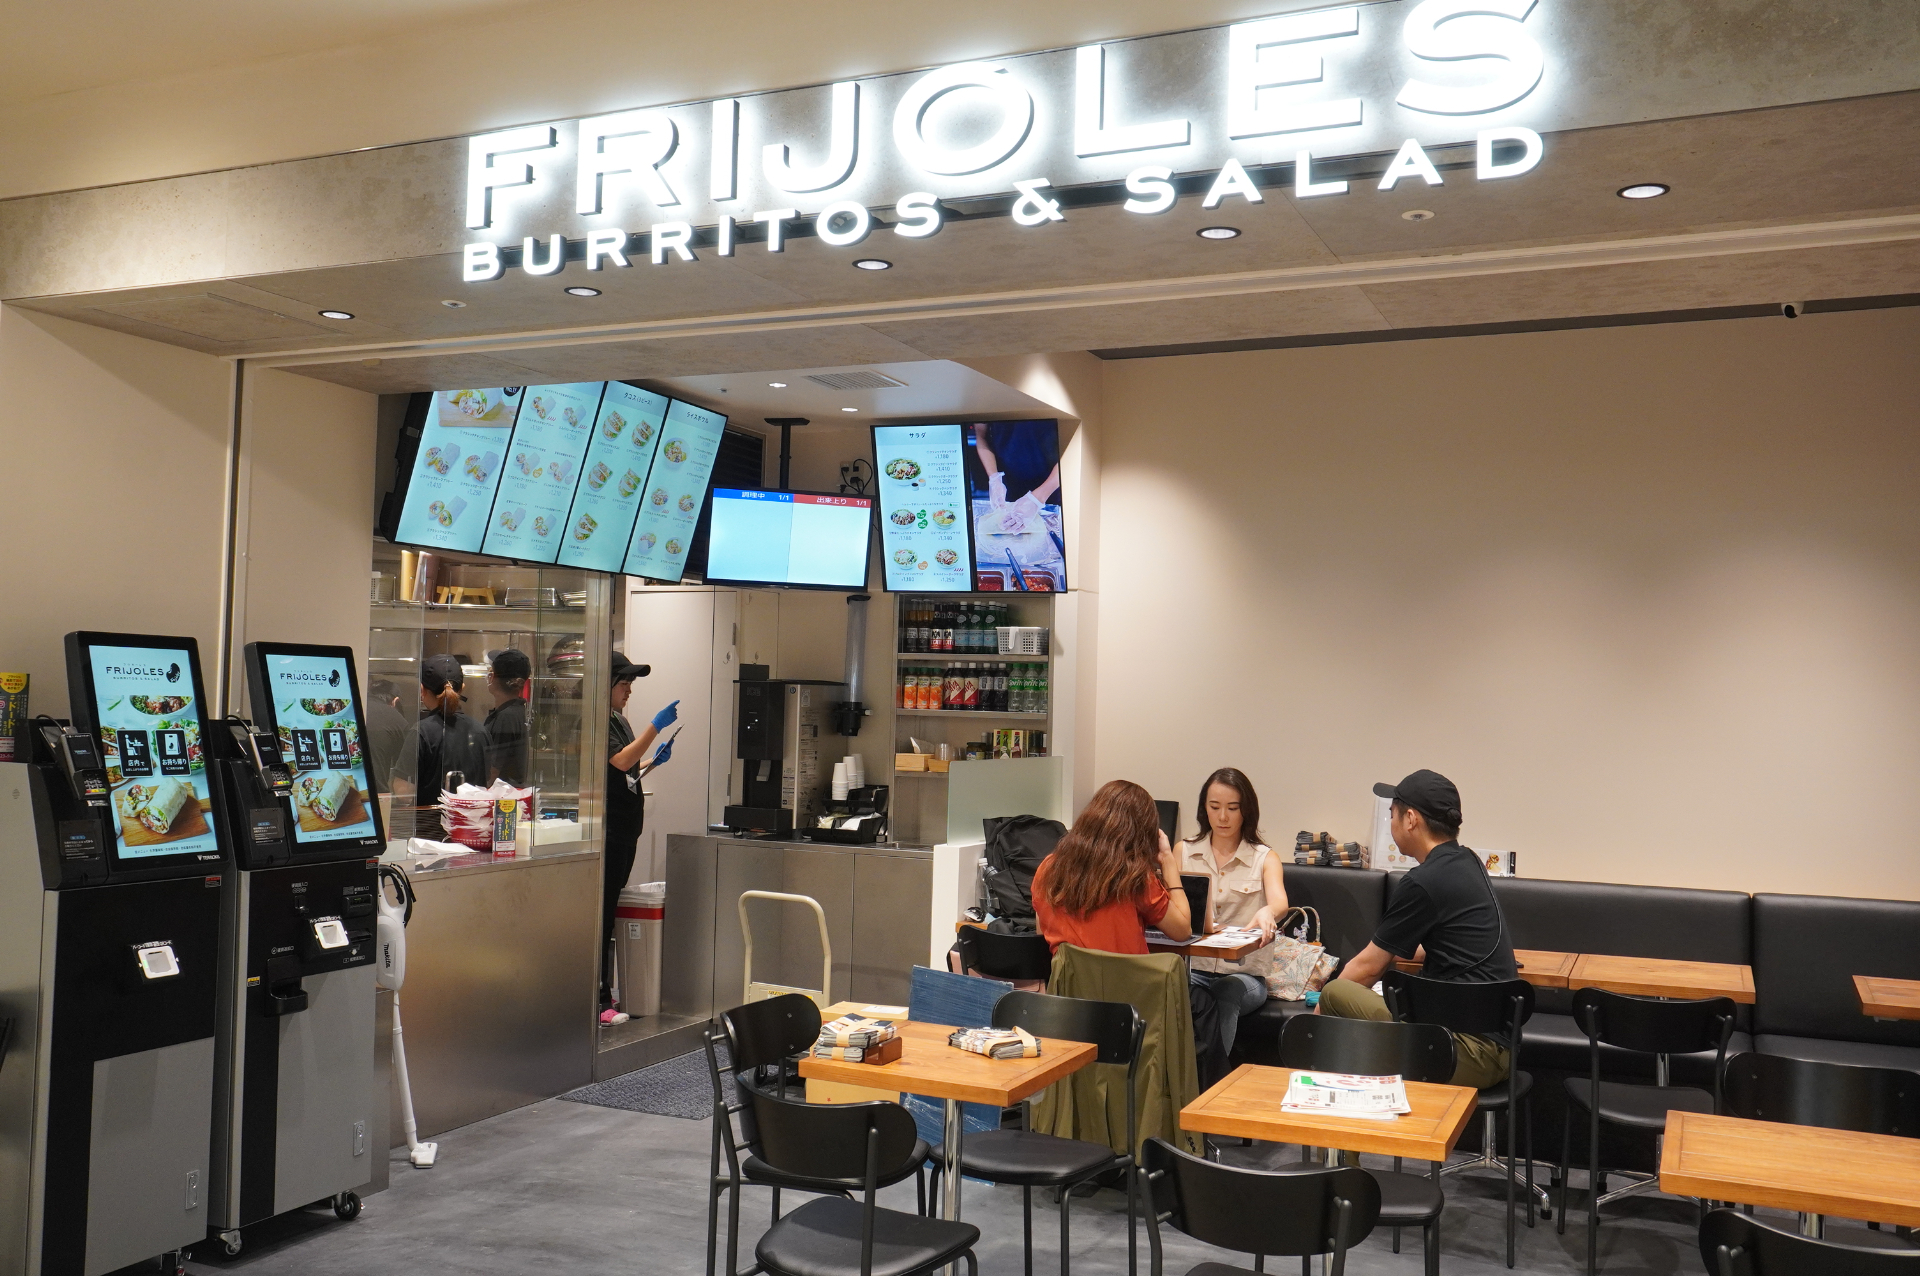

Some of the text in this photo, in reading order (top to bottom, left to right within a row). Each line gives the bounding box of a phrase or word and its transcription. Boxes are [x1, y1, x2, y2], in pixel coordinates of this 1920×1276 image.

[466, 0, 1545, 229] FRIJOLES
[463, 126, 1546, 283] BURRITOS & SALAD
[741, 490, 767, 499] 調理中
[816, 496, 867, 507] 出来上り 1/1
[105, 666, 165, 677] FRIJOLES
[279, 672, 328, 682] FRIJOLES
[127, 758, 145, 767] 店内で
[161, 758, 187, 766] お持ち帰り
[383, 943, 392, 969] makita
